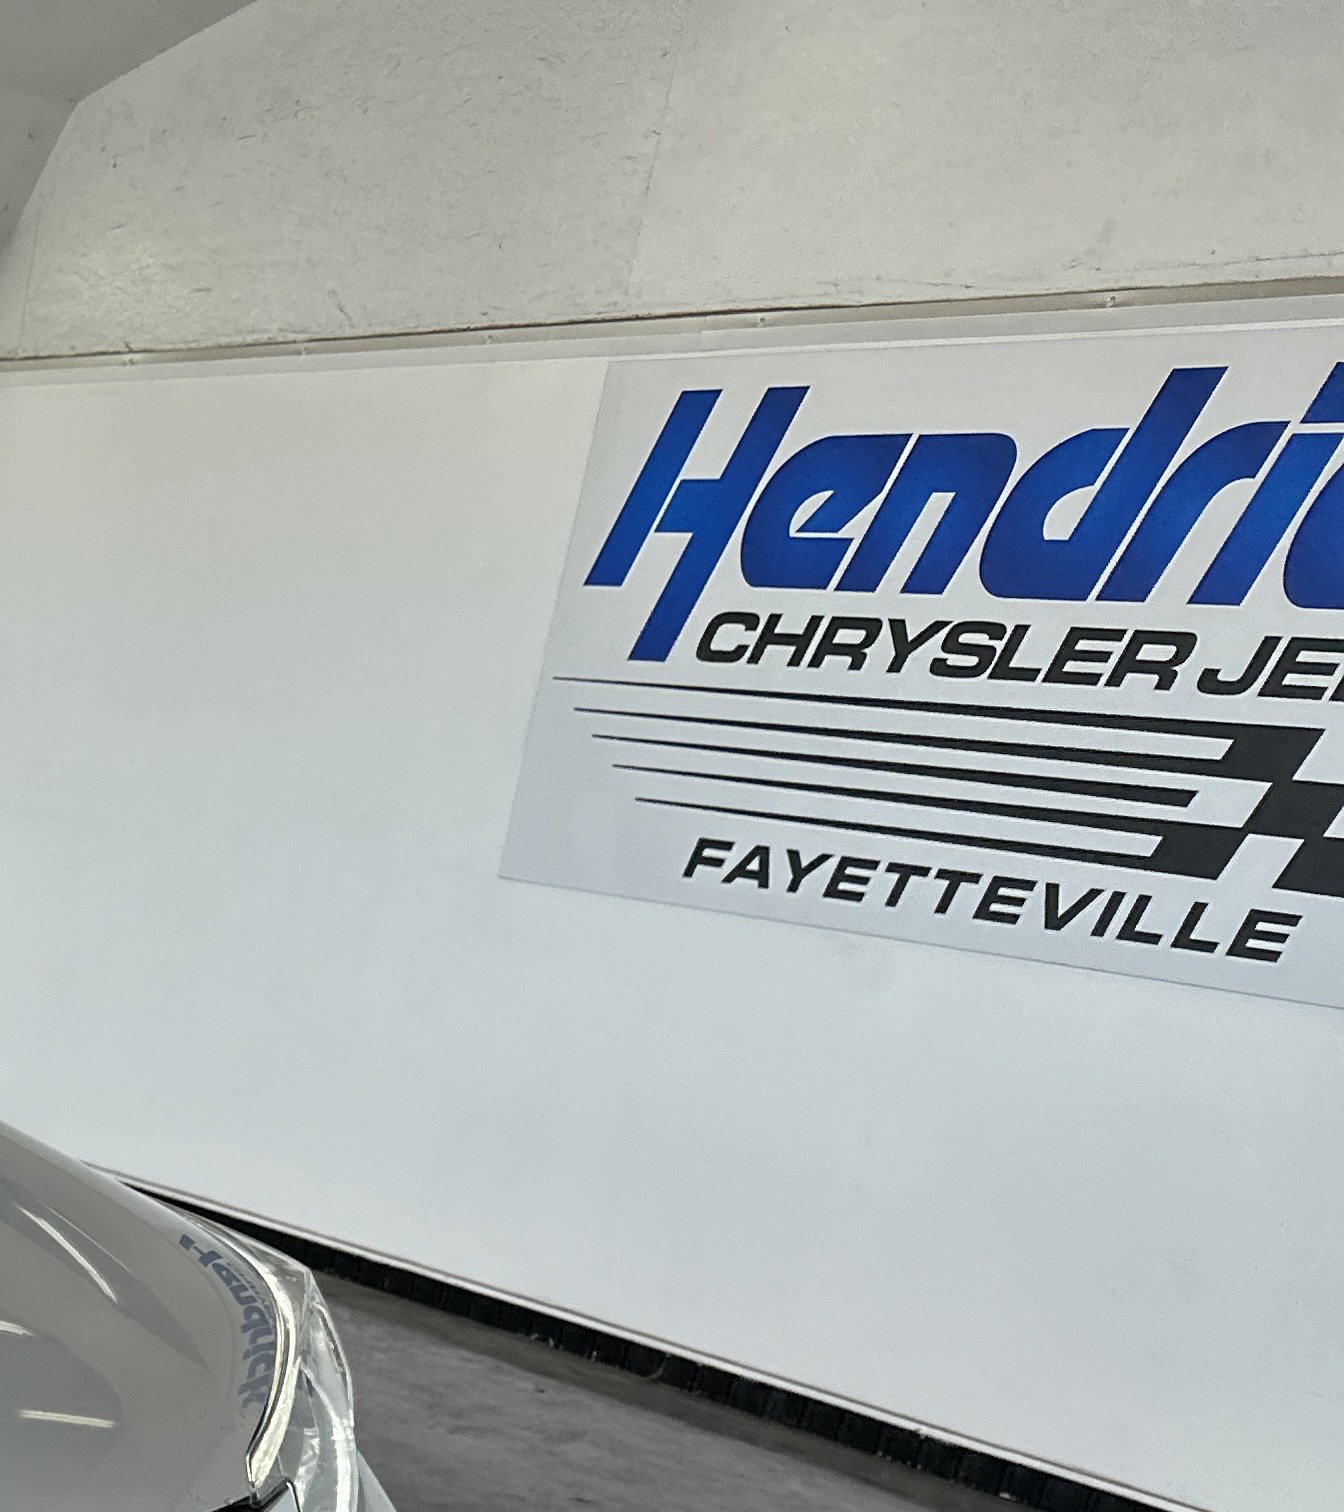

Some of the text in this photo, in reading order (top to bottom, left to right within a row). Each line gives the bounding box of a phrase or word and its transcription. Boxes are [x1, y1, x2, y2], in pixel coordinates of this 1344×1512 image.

[695, 610, 1344, 702] CHRYSLER JE
[681, 836, 1304, 964] FAYETTEVILLE
